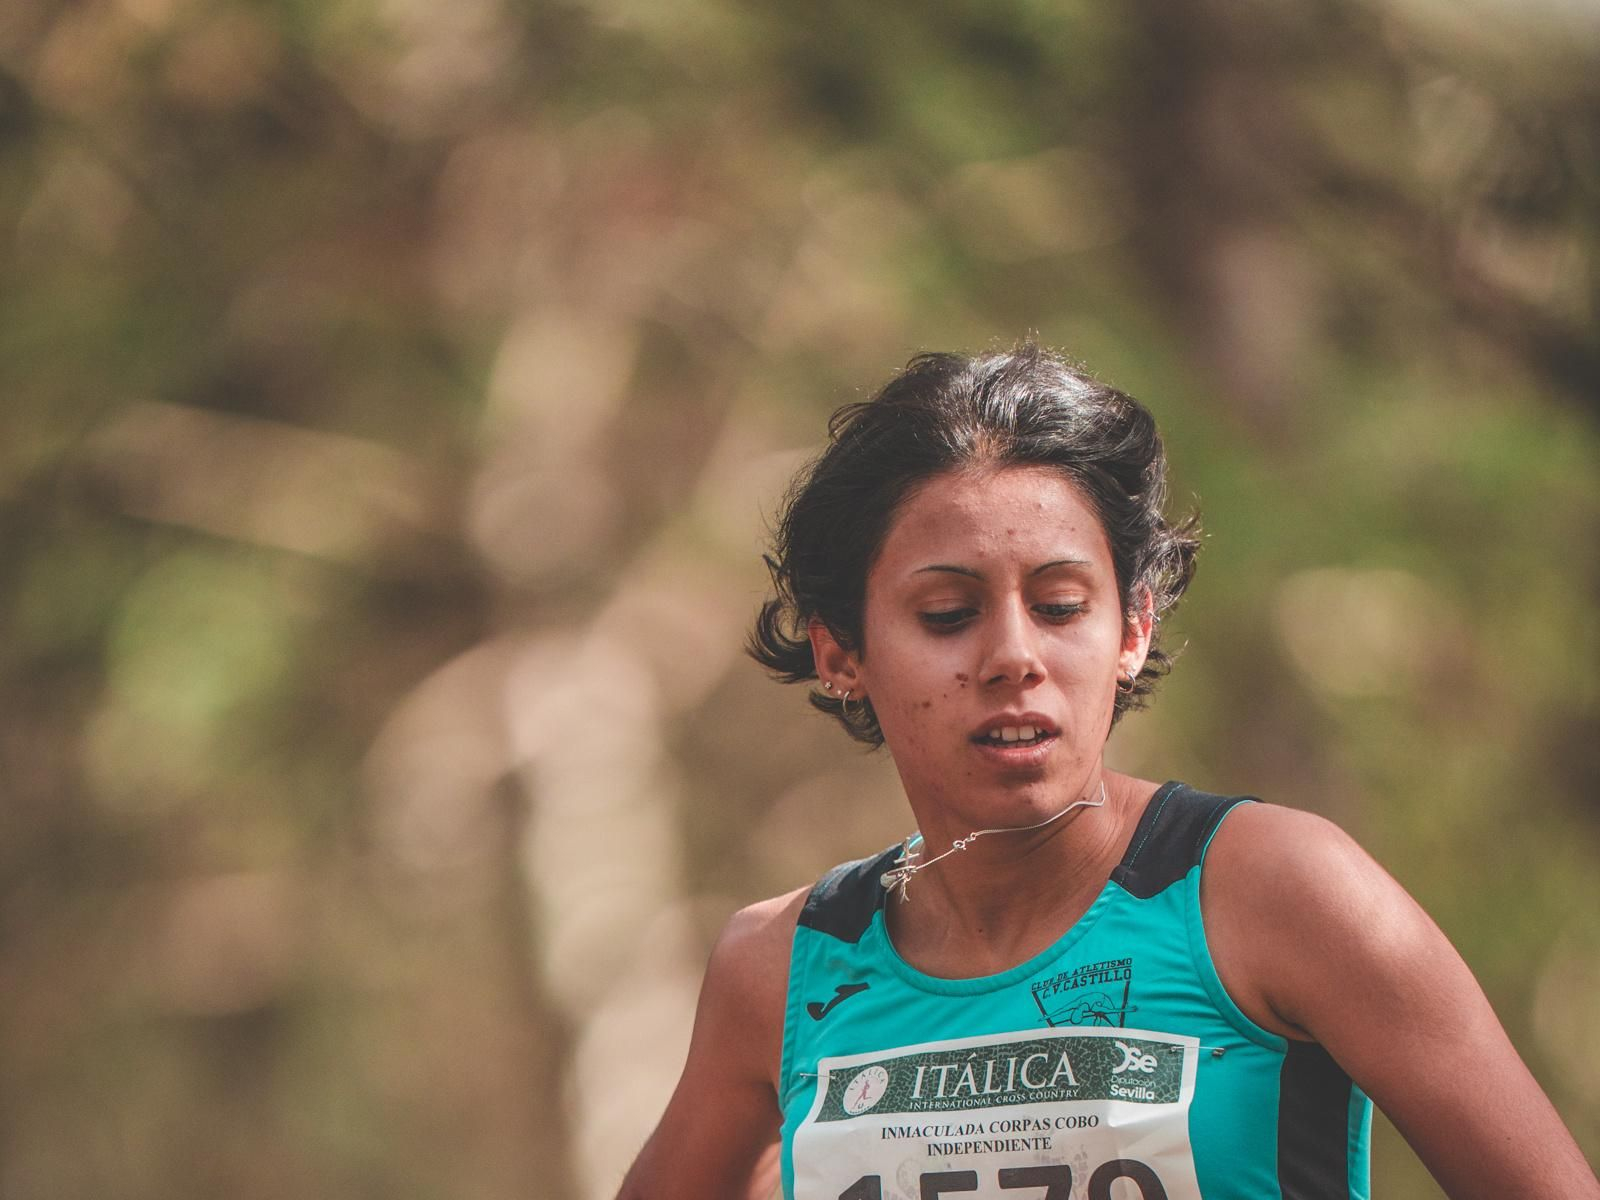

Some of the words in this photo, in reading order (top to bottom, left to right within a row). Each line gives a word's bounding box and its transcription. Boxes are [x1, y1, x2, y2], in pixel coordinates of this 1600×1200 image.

[1072, 958, 1133, 976] ATLETISMO
[909, 1051, 1080, 1099] ITÁLICA
[909, 1097, 992, 1110] INTERNATIONAL
[995, 1094, 1026, 1104] CROSS
[1029, 1089, 1080, 1100] COUNTRY
[1110, 1084, 1155, 1100] Sevilla
[881, 1123, 985, 1140] INMACULADA
[989, 1117, 1051, 1134] CORPAS
[1054, 1114, 1100, 1130] COBO
[927, 1136, 1052, 1156] INDEPENDIENTE
